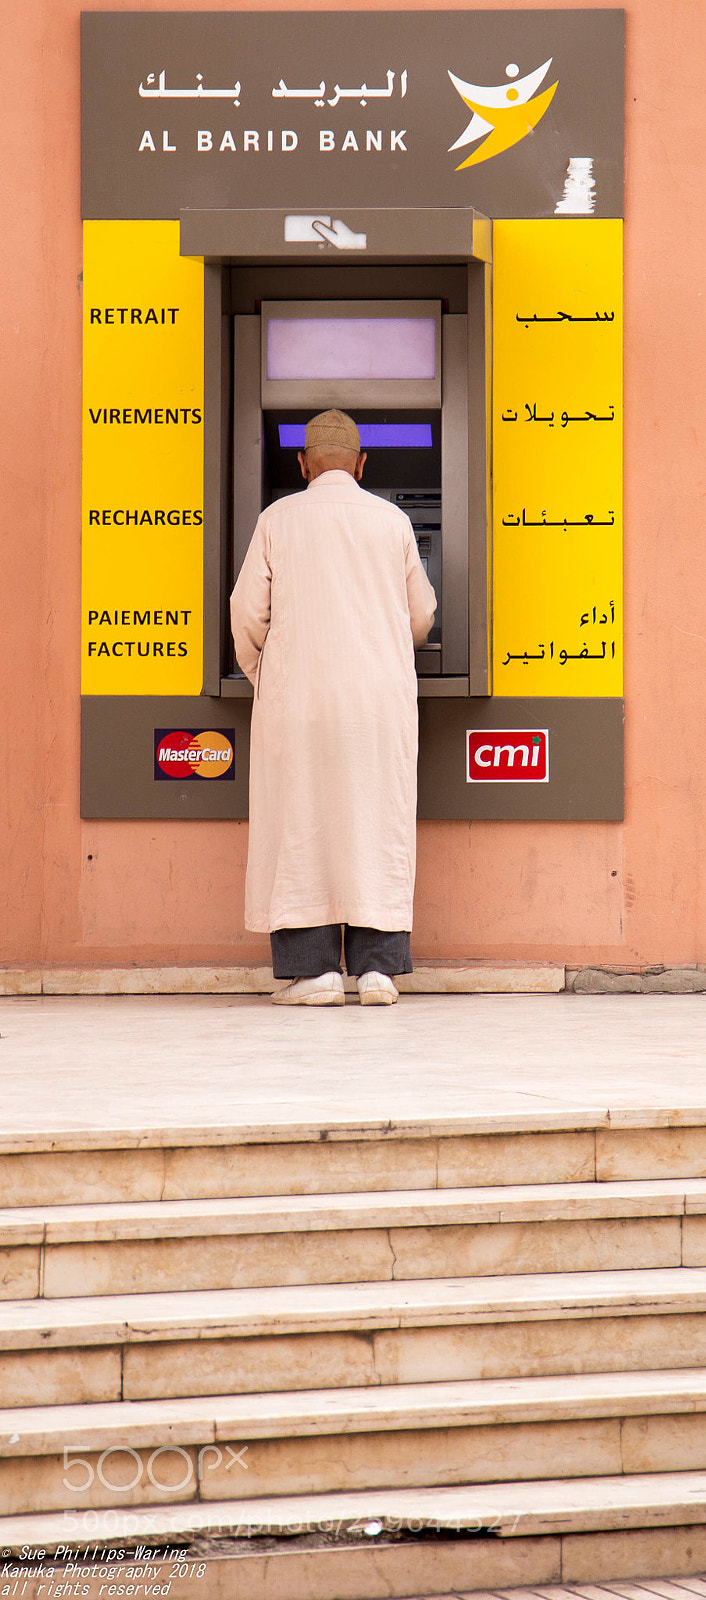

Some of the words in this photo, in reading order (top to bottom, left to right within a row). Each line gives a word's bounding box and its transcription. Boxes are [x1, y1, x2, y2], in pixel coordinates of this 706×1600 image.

[138, 68, 242, 108] بنك
[271, 68, 408, 108] البريد
[138, 130, 178, 152] AL
[197, 130, 300, 152] BARID
[319, 130, 409, 152] BANK
[89, 308, 180, 325] RETRAIT
[515, 309, 615, 328] سحب
[88, 408, 203, 425] VIREMENTS
[501, 403, 615, 428] تحويلات
[88, 509, 204, 526] RECHARGES
[501, 508, 615, 532] تعبئات
[87, 610, 192, 626] PAIEMENT
[579, 600, 616, 628] أداء
[87, 641, 189, 657] FACTURES
[501, 641, 616, 665] الفواتير
[157, 746, 232, 763] MasterCard
[473, 736, 541, 768] cmi
